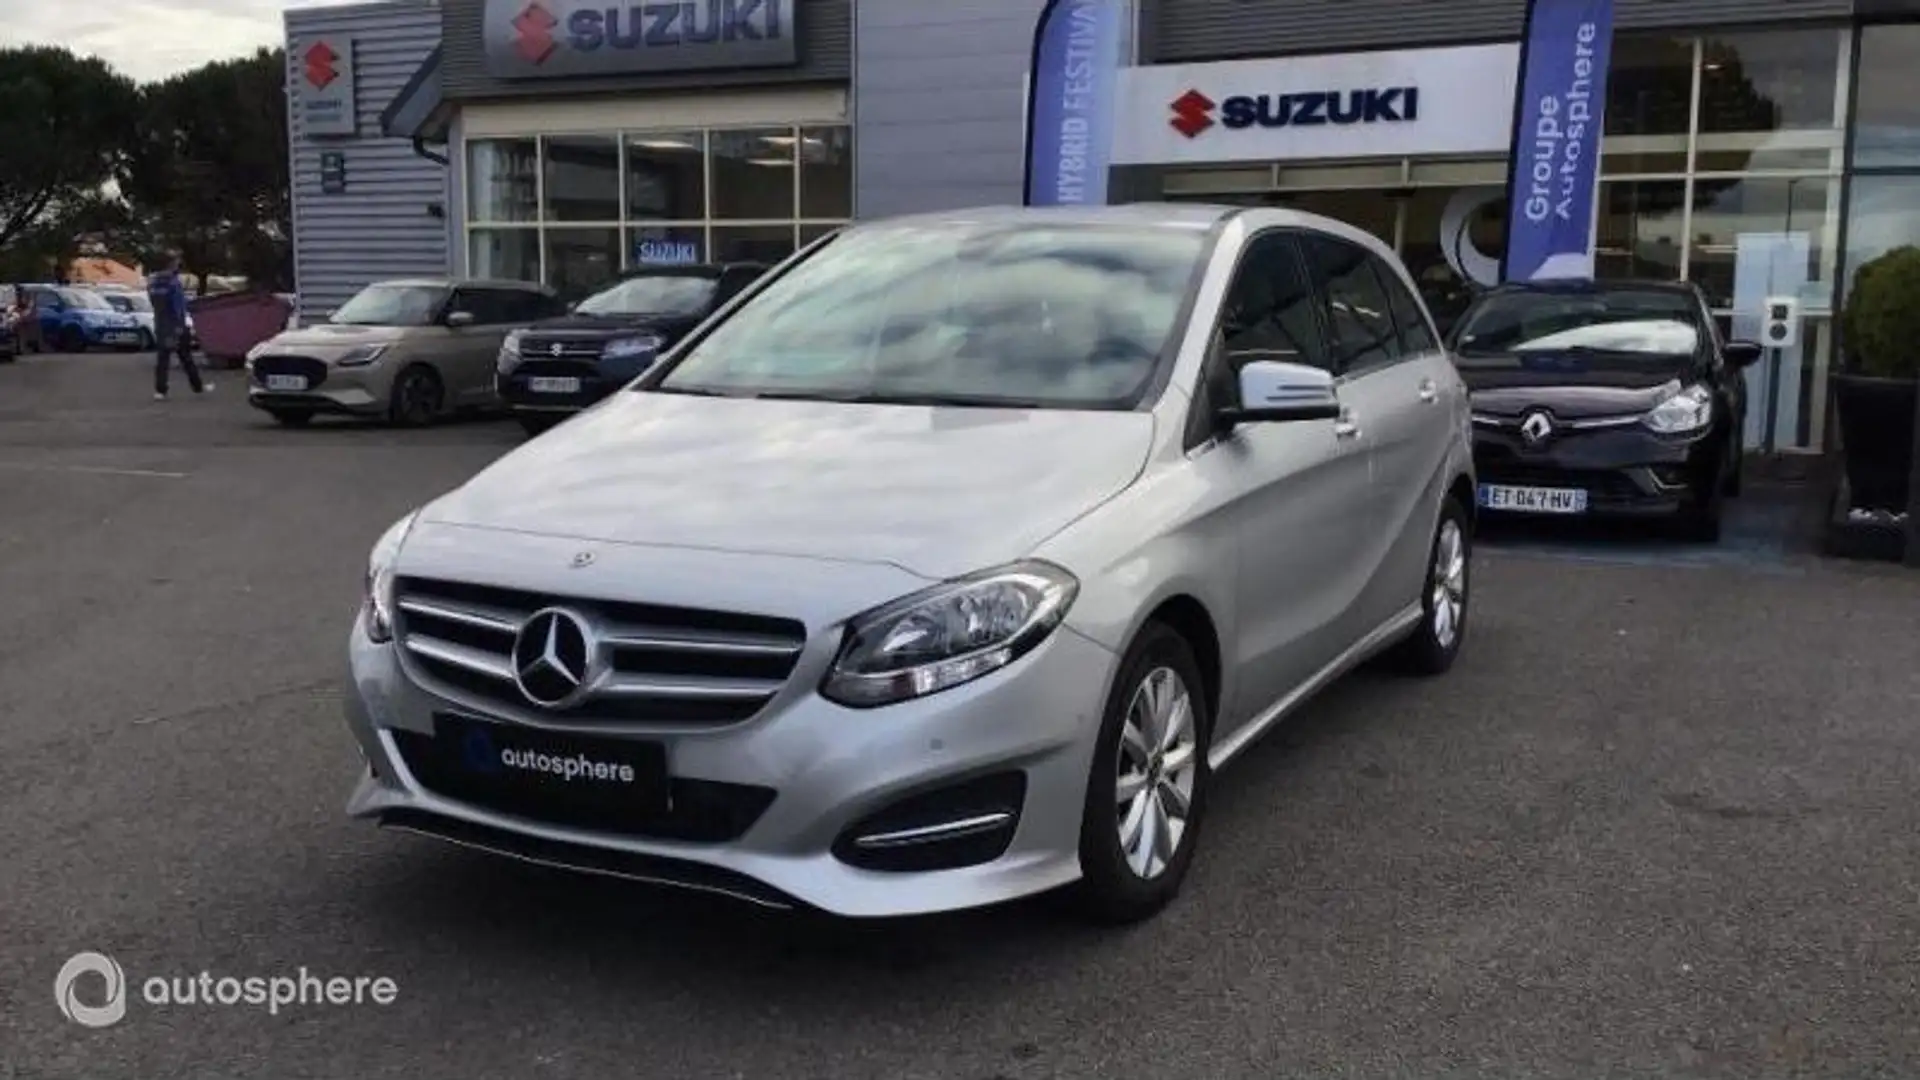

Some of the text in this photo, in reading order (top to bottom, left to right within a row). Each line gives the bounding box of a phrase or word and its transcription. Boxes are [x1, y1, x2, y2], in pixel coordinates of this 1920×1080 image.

[567, 0, 779, 52] SUZUKI
[1056, 0, 1098, 202] HYBRID FESTIVA
[1221, 87, 1419, 129] SUZUKI
[1555, 22, 1596, 220] Autosphere
[1524, 95, 1563, 221] Groupe
[501, 748, 635, 782] autosphere
